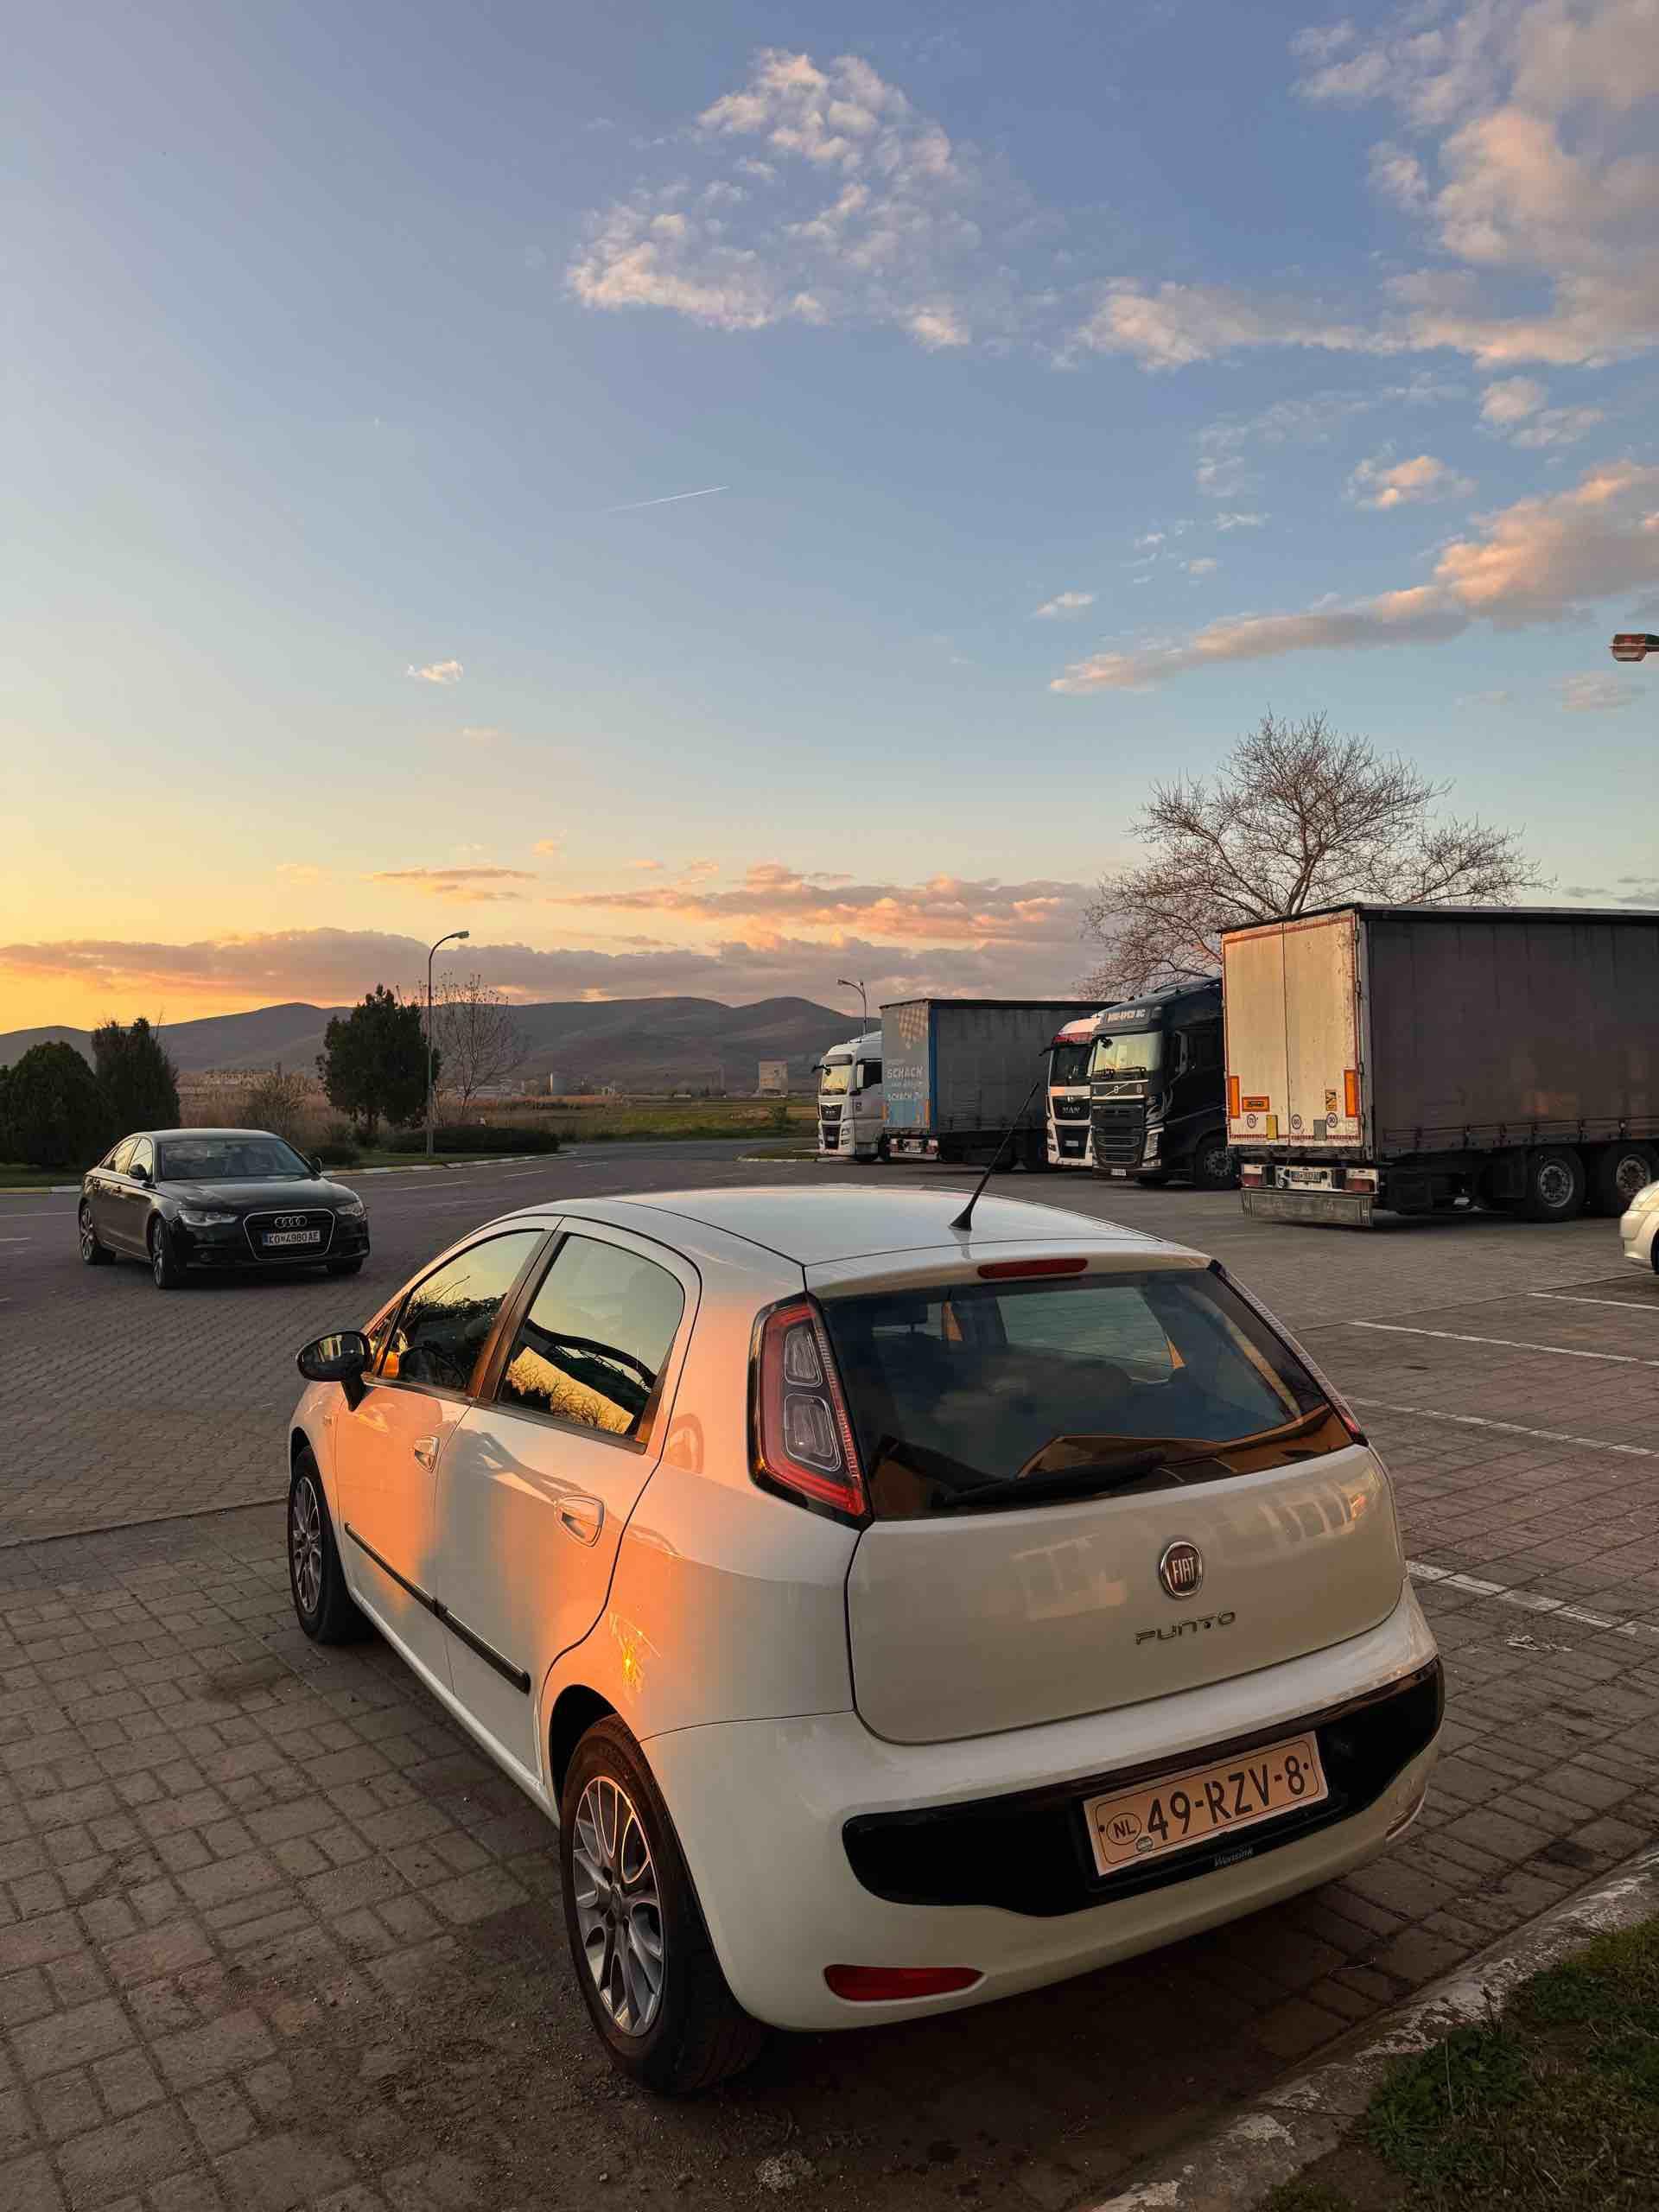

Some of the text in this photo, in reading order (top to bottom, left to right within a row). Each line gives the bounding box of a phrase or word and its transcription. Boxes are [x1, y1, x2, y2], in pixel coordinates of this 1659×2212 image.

[1171, 1557, 1195, 1584] FIAT
[1134, 1611, 1236, 1645] PUNTO
[1113, 1755, 1306, 1840] NL 49-RZV-8
